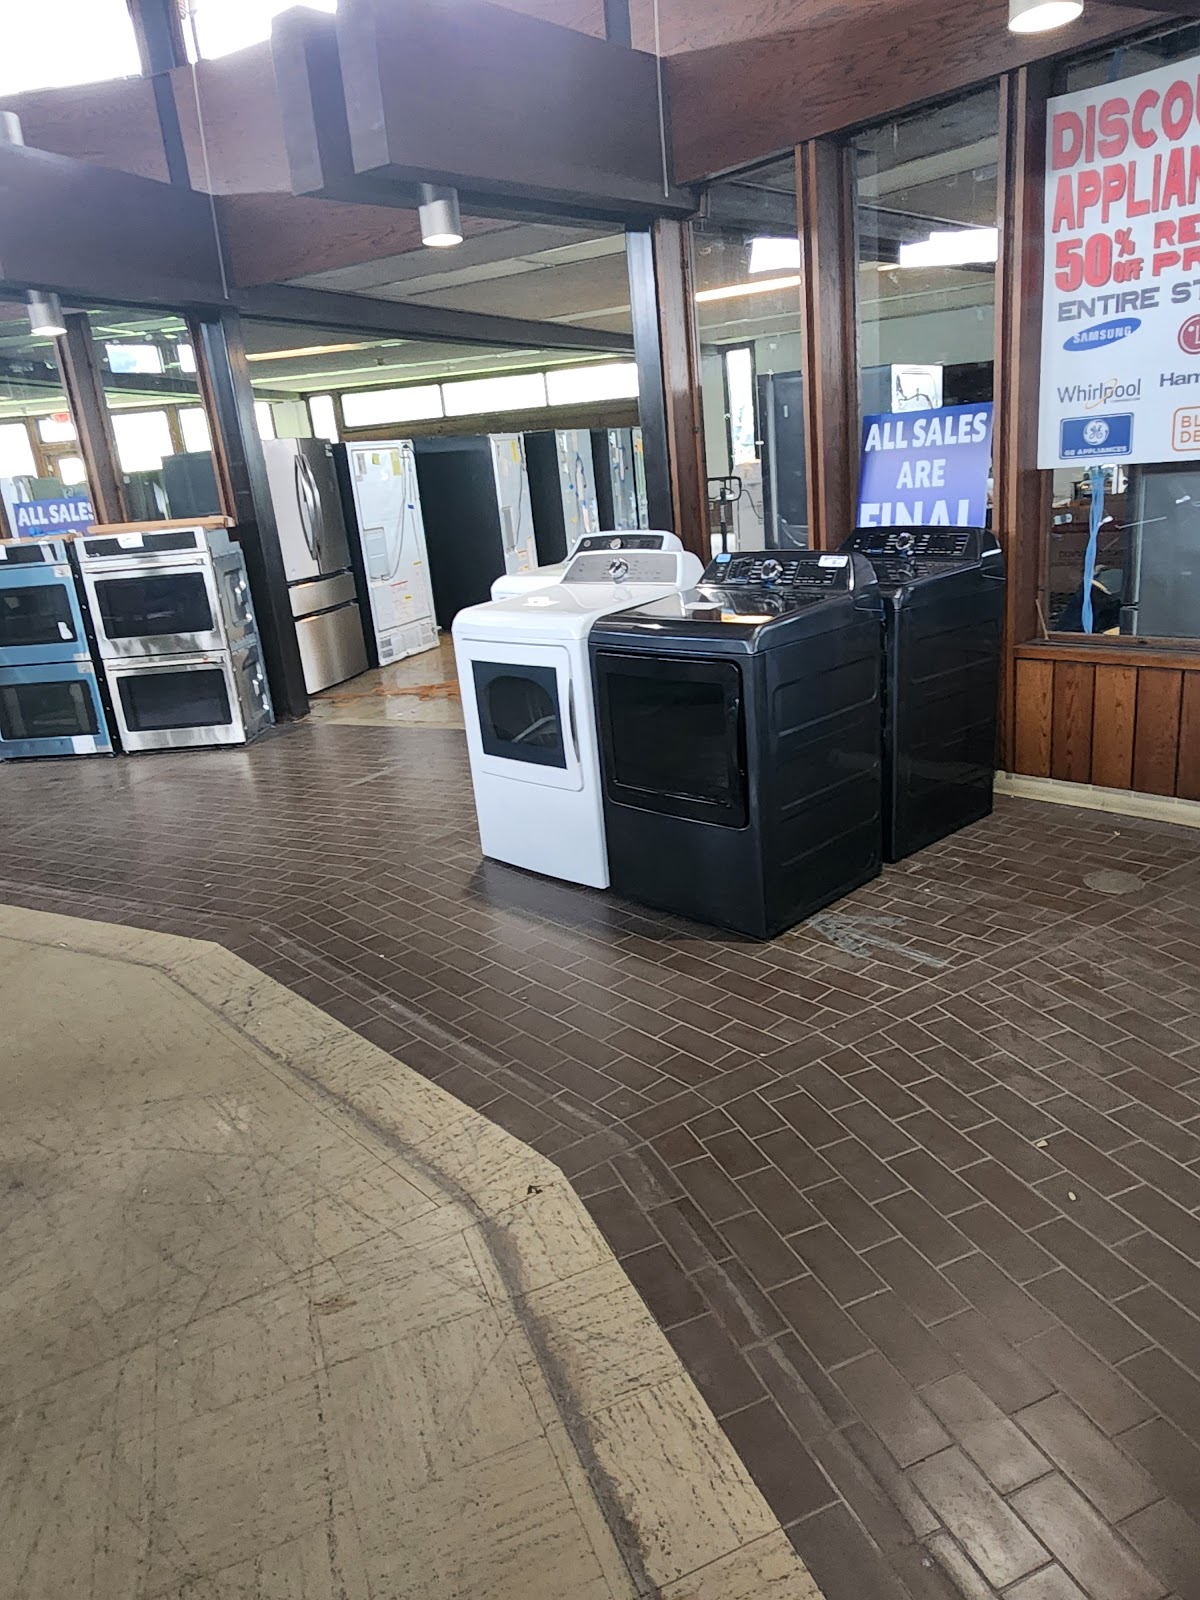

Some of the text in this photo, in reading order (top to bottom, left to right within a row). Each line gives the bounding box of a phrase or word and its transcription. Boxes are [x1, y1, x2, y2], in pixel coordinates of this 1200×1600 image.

[1052, 73, 1200, 171] DISCO
[1153, 214, 1200, 249] RE
[1152, 245, 1200, 277] PR
[1057, 286, 1161, 322] ENTIRE
[1072, 325, 1133, 344] SAMSUNG
[1057, 378, 1142, 404] Whirlpool
[1160, 372, 1200, 387] Ham
[864, 411, 988, 451] ALL SALES
[896, 458, 946, 489] ARE
[17, 505, 50, 527] ALL
